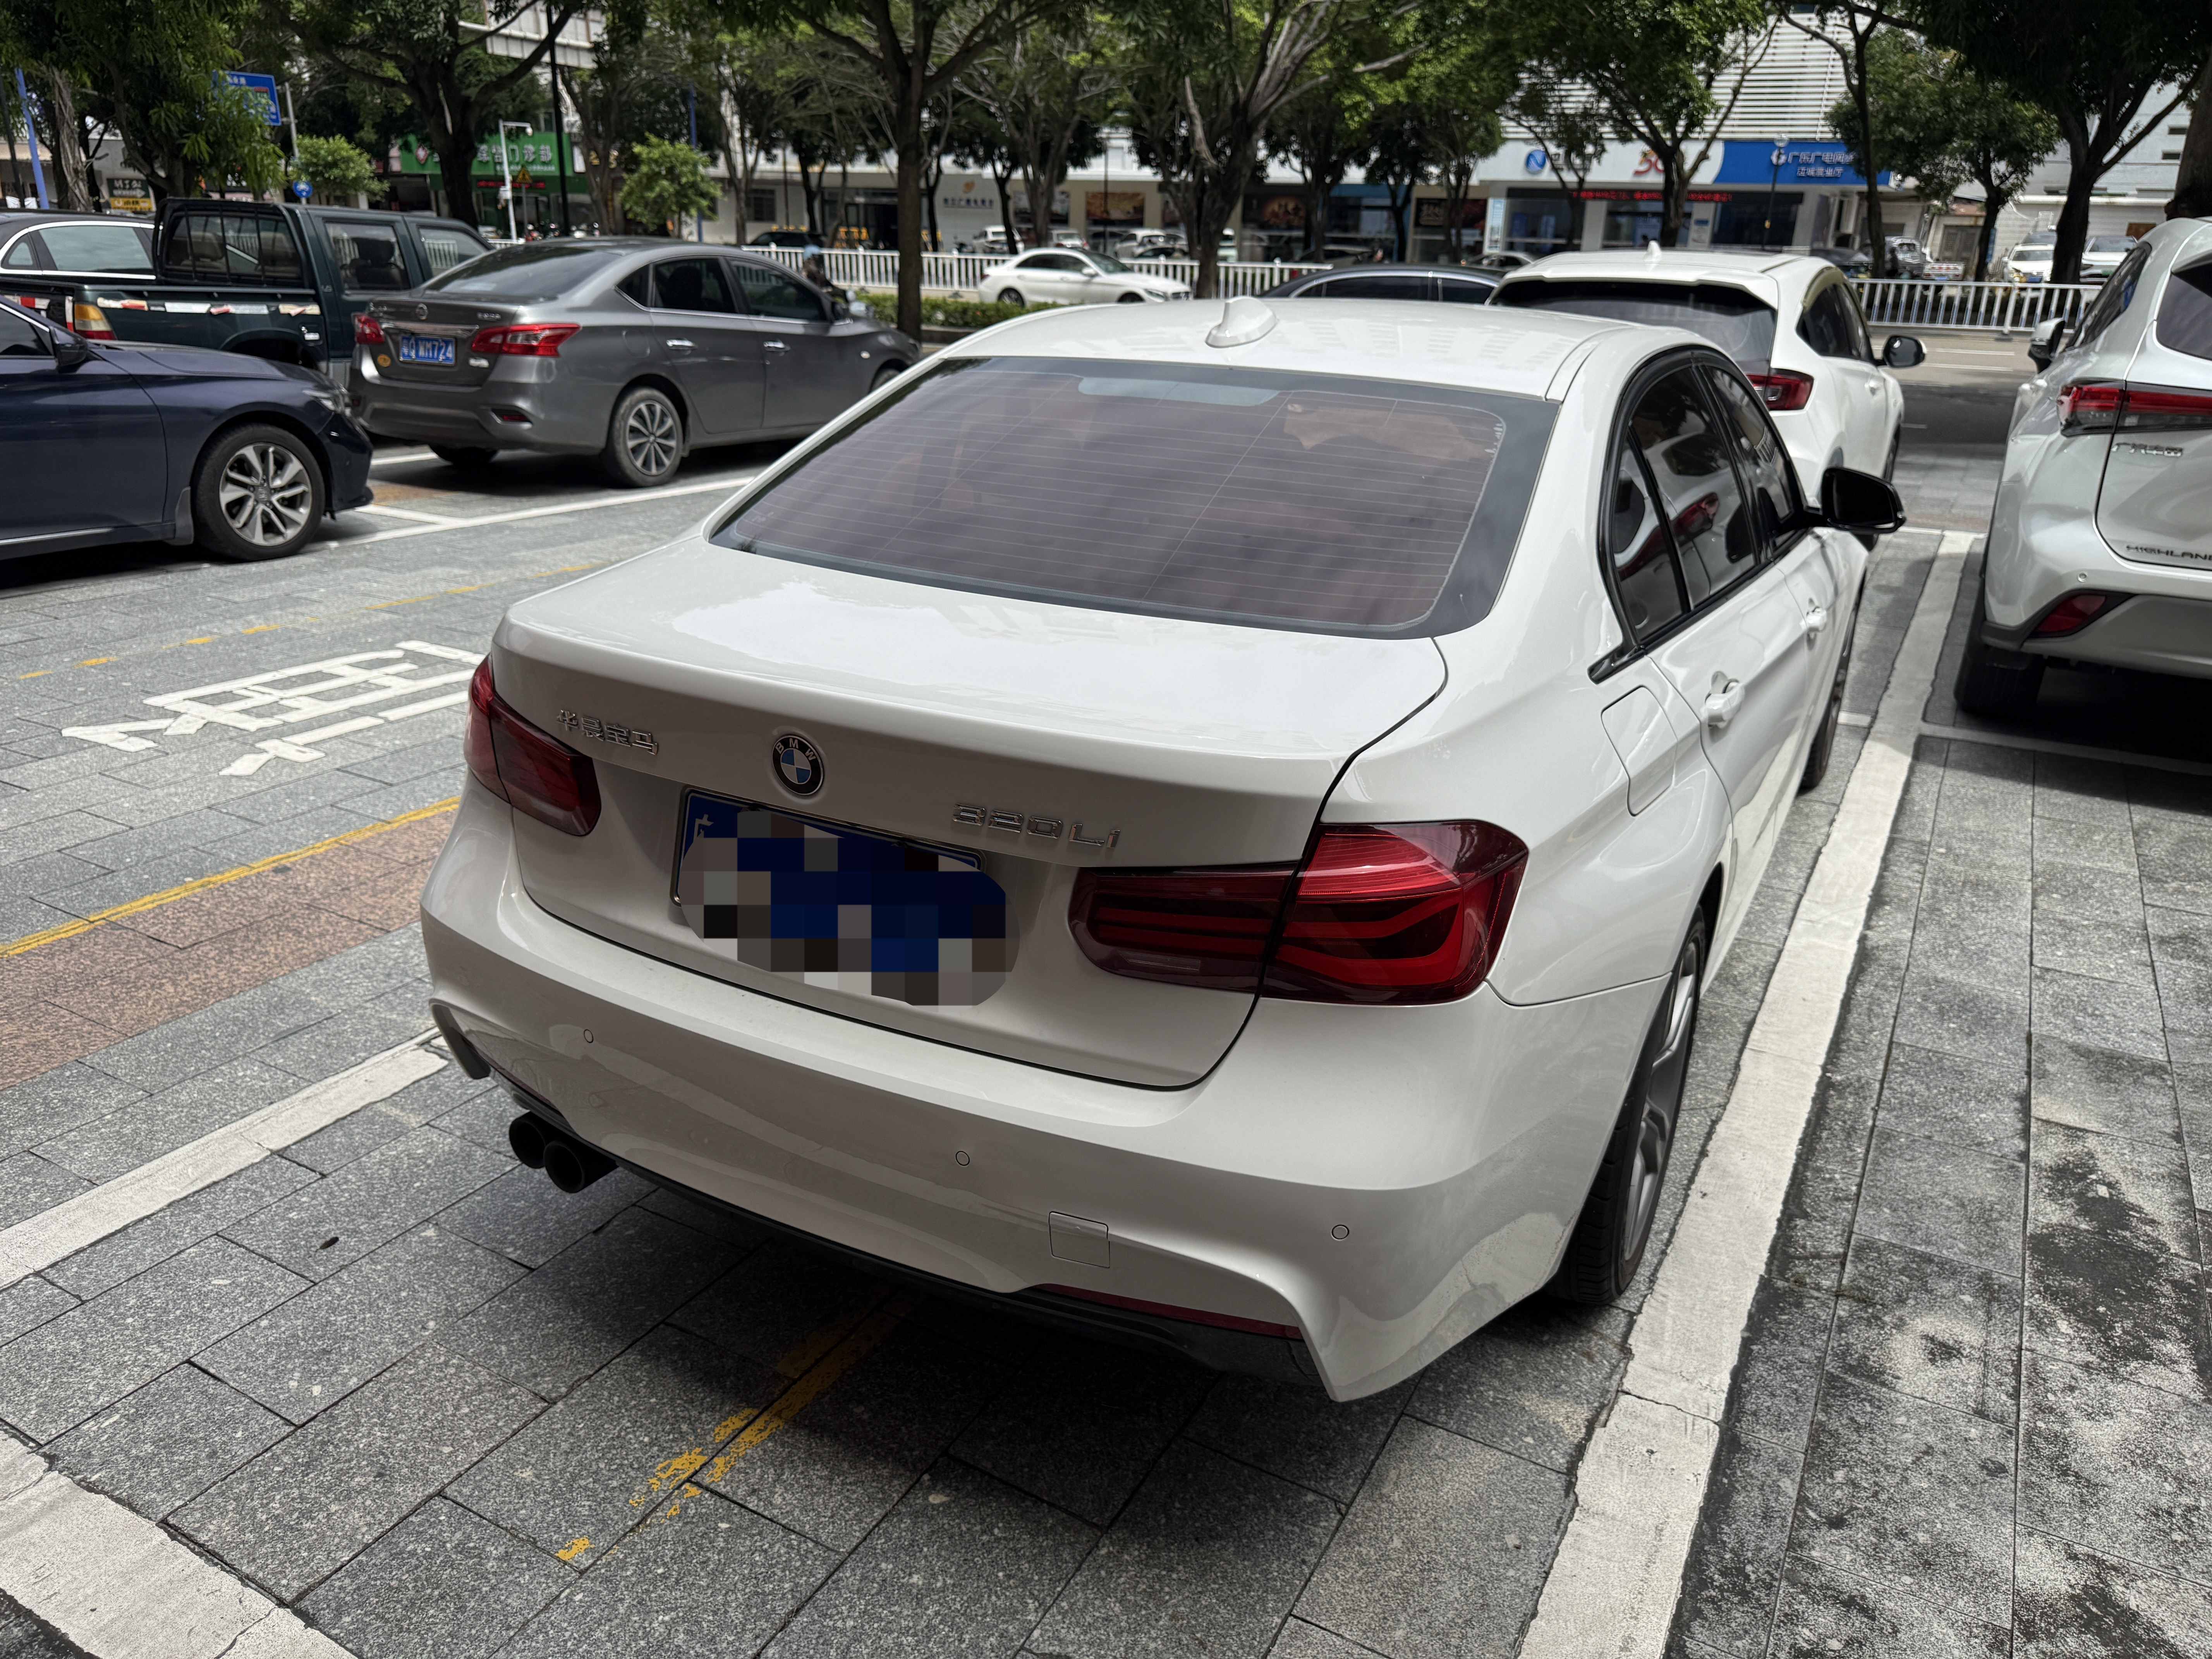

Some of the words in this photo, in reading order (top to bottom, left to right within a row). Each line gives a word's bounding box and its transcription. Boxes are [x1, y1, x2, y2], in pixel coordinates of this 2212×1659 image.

[557, 709, 658, 755] 华晨宝马
[775, 738, 816, 761] BMW
[953, 803, 1121, 848] 320Li
